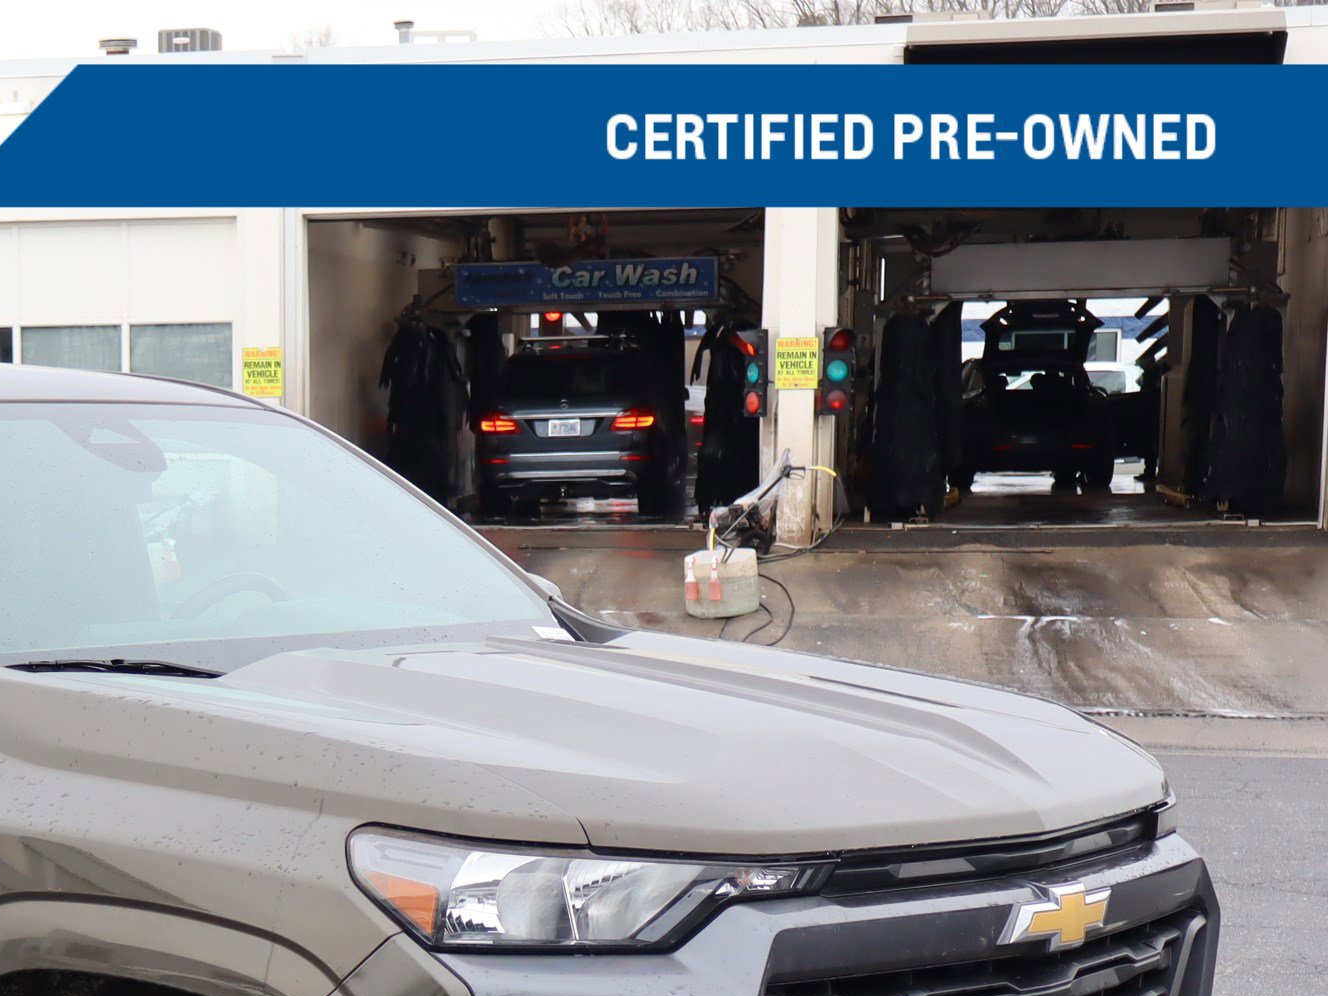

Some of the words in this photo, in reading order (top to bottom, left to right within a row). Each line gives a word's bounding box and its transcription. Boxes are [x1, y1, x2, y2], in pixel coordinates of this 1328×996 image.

[552, 265, 605, 289] Car
[615, 262, 698, 287] Wash
[777, 351, 807, 360] REMAIN
[809, 351, 817, 360] IN
[244, 361, 273, 369] REMAIN
[274, 361, 282, 369] IN
[779, 361, 814, 369] VEHICLE
[247, 370, 279, 379] VEHICLE
